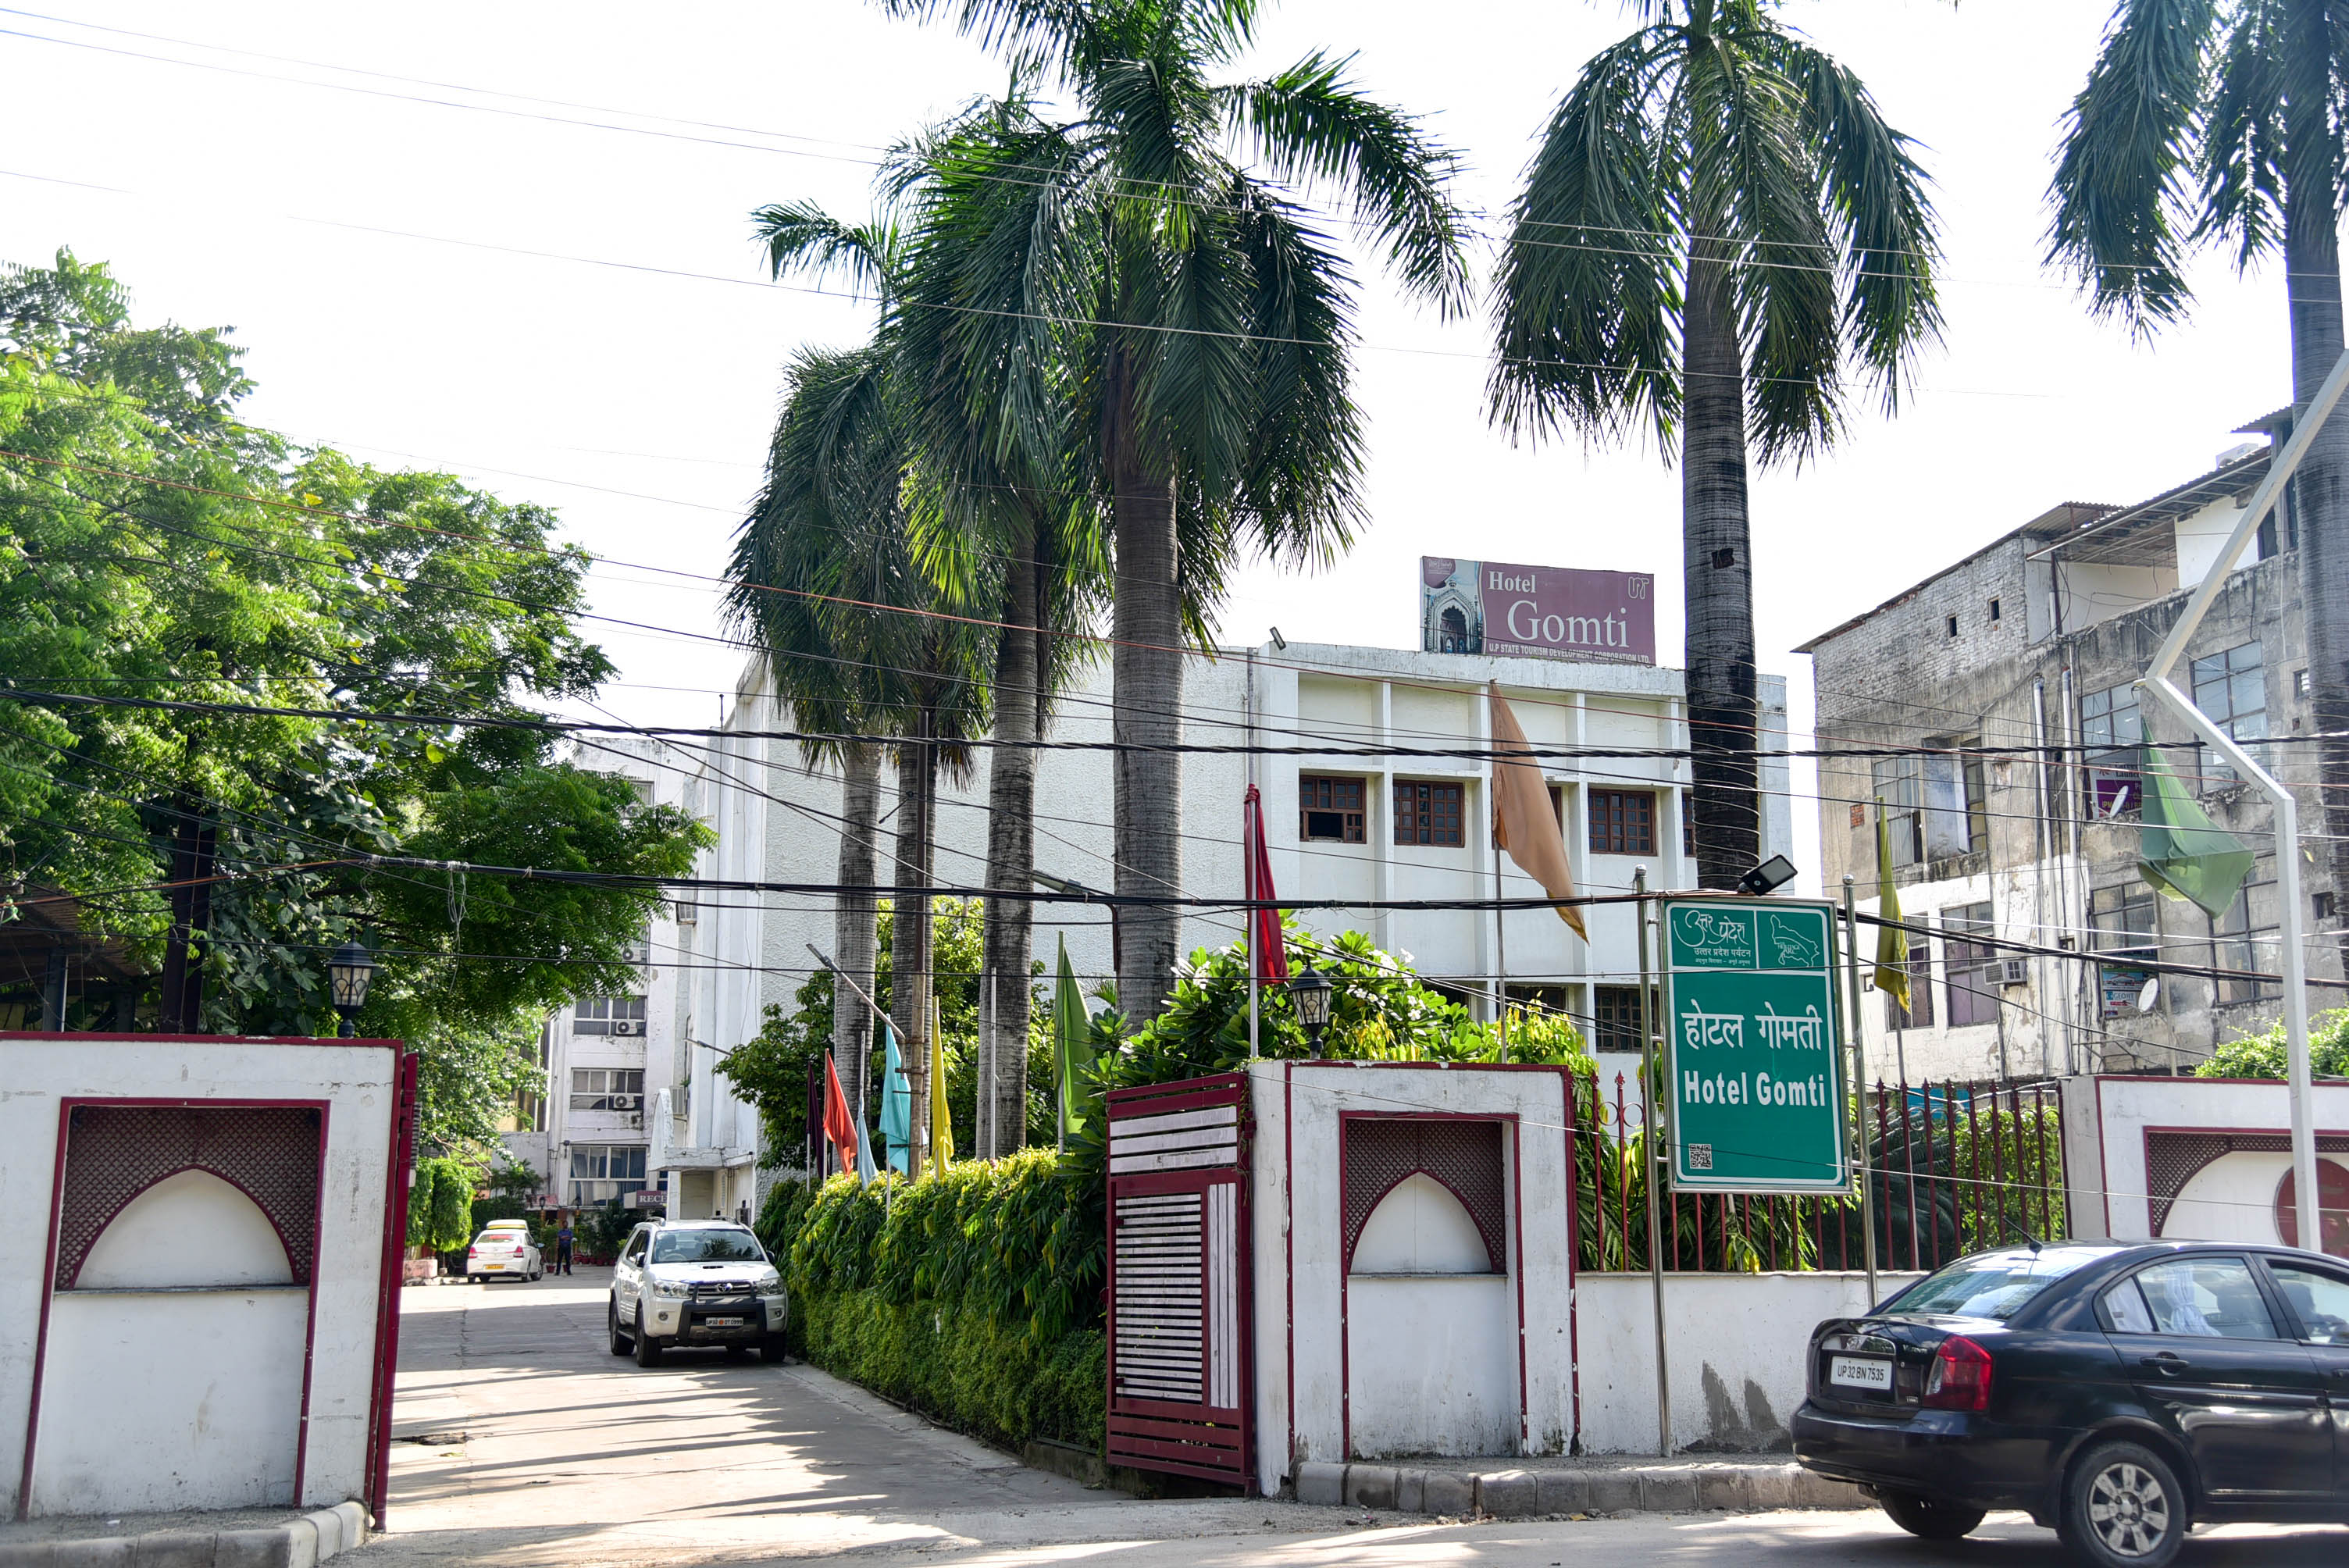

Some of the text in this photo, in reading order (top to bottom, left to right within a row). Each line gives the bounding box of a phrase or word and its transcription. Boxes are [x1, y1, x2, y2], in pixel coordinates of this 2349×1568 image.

[1488, 571, 1536, 593] Hotel
[1507, 600, 1629, 648] Gomti
[1500, 644, 1519, 654] STATE
[1520, 646, 1548, 656] TOURISM
[1549, 648, 1593, 659] DEVELOPMENT
[1681, 999, 1823, 1050] होटल गोमती
[1684, 1070, 1826, 1107] Hotel Gomti
